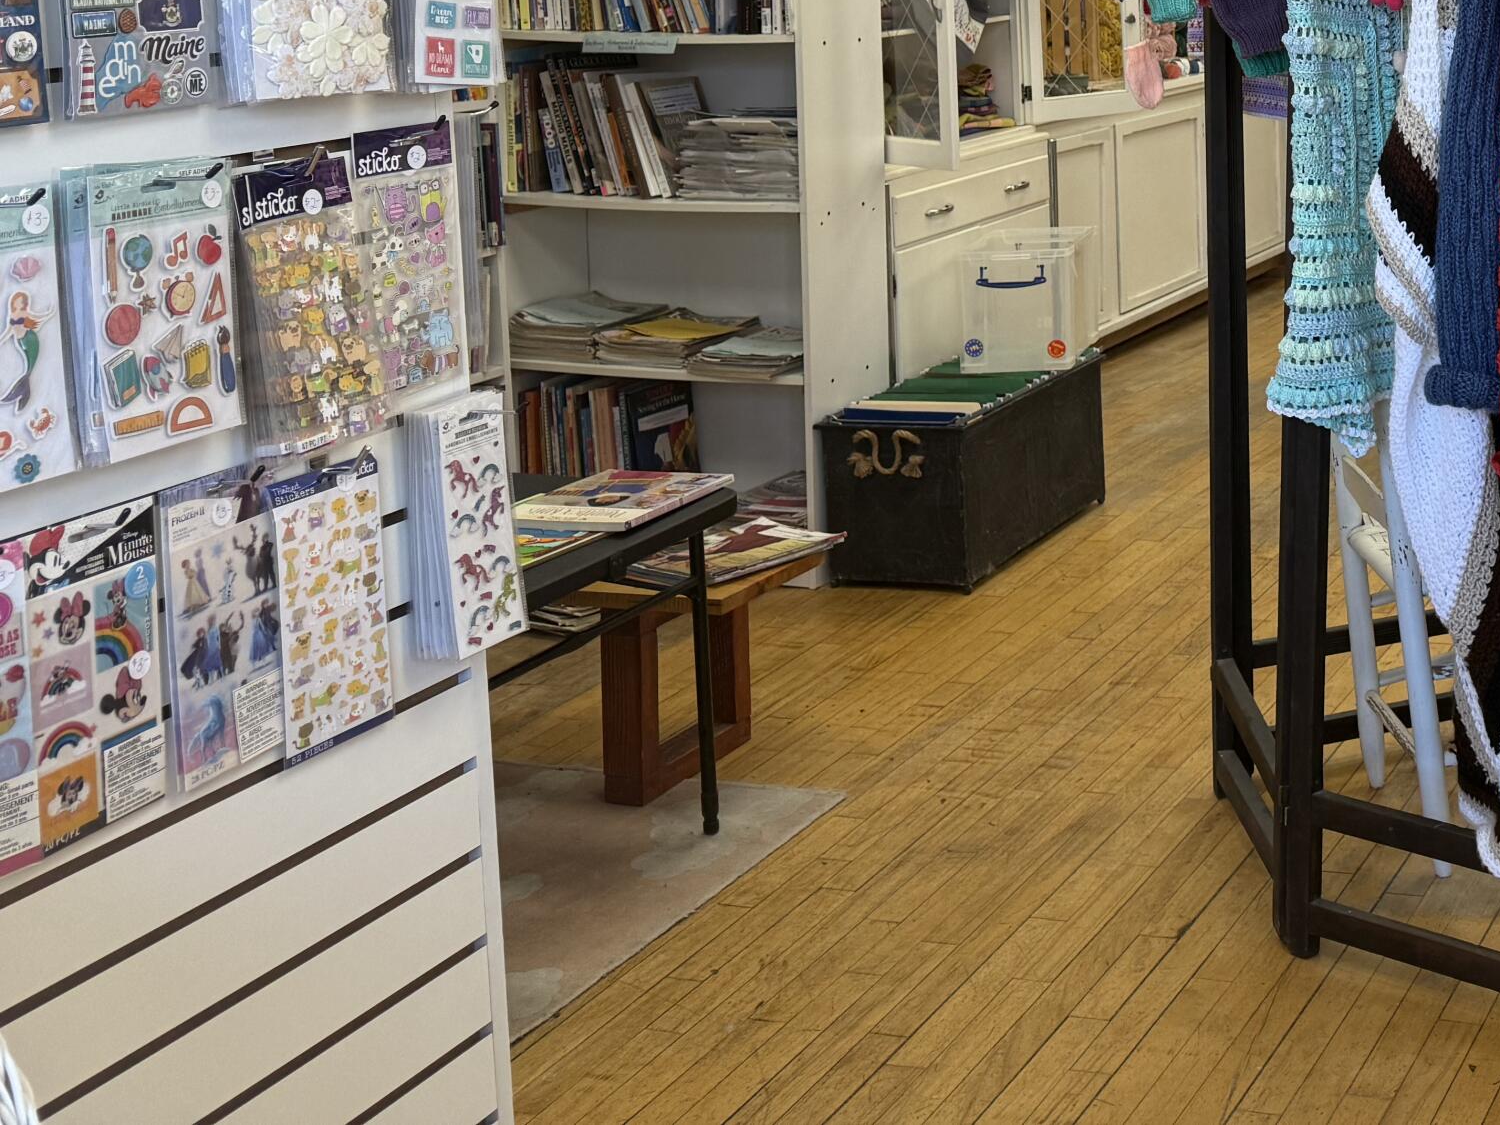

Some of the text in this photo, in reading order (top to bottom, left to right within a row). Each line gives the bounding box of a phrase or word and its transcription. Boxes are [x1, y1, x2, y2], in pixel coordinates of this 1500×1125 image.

[83, 18, 107, 31] MAINE
[140, 36, 204, 64] Maine
[189, 78, 204, 93] ME
[549, 100, 574, 164] MAKING MARLS
[358, 147, 402, 176] sticko
[255, 188, 299, 221] sticko
[274, 486, 315, 506] Stickers
[171, 511, 198, 527] FROZEN
[135, 565, 145, 580] 2
[304, 738, 334, 759] PIECES
